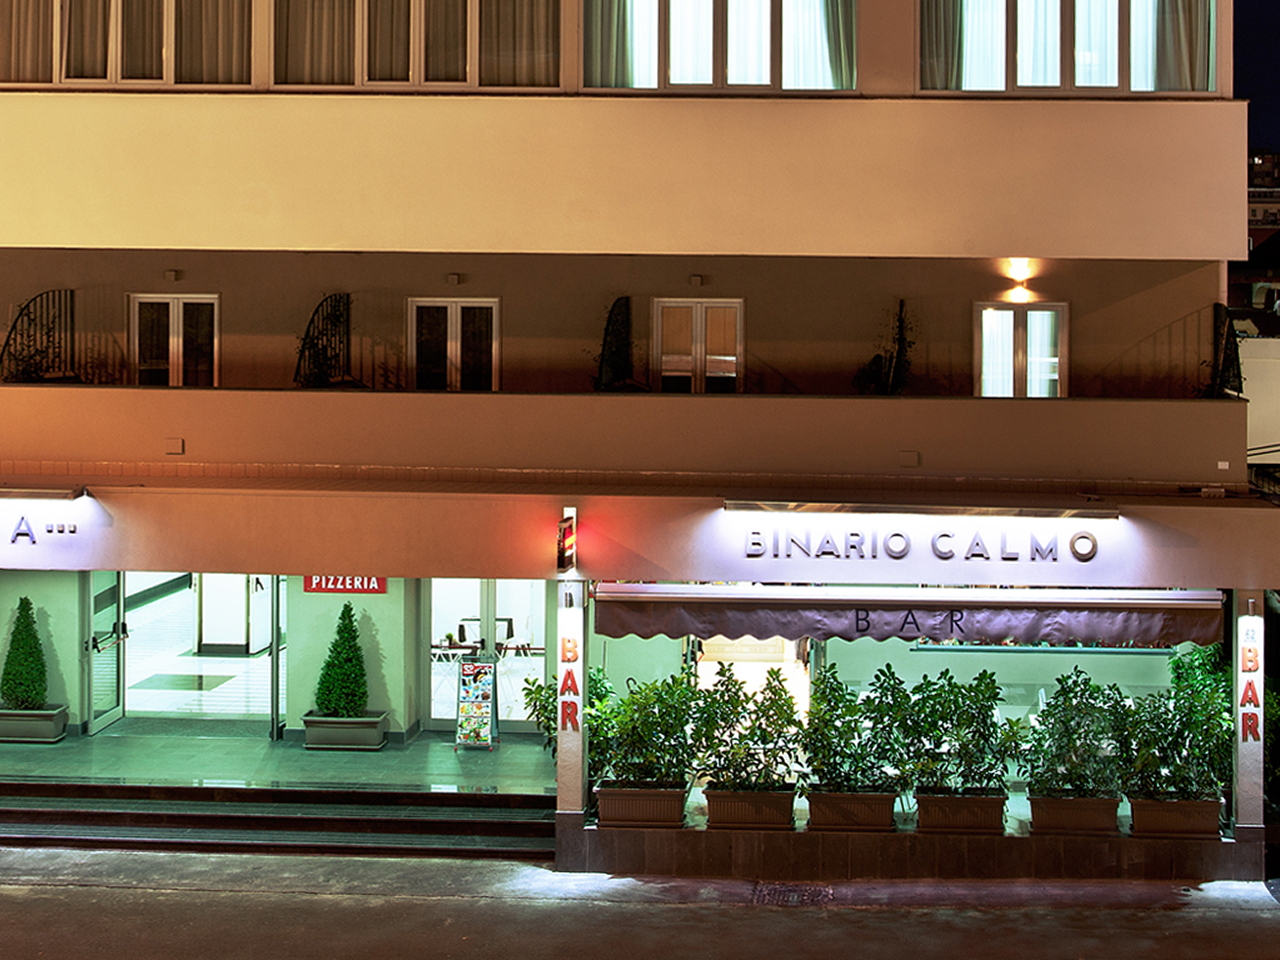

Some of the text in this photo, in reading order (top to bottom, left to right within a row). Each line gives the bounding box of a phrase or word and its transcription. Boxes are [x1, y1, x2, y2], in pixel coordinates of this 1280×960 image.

[744, 528, 1099, 563] BINARIO CALMO
[311, 575, 379, 590] PIZZERIA
[854, 608, 966, 635] BAR
[561, 637, 580, 732] BAR
[1240, 647, 1261, 742] BAR
